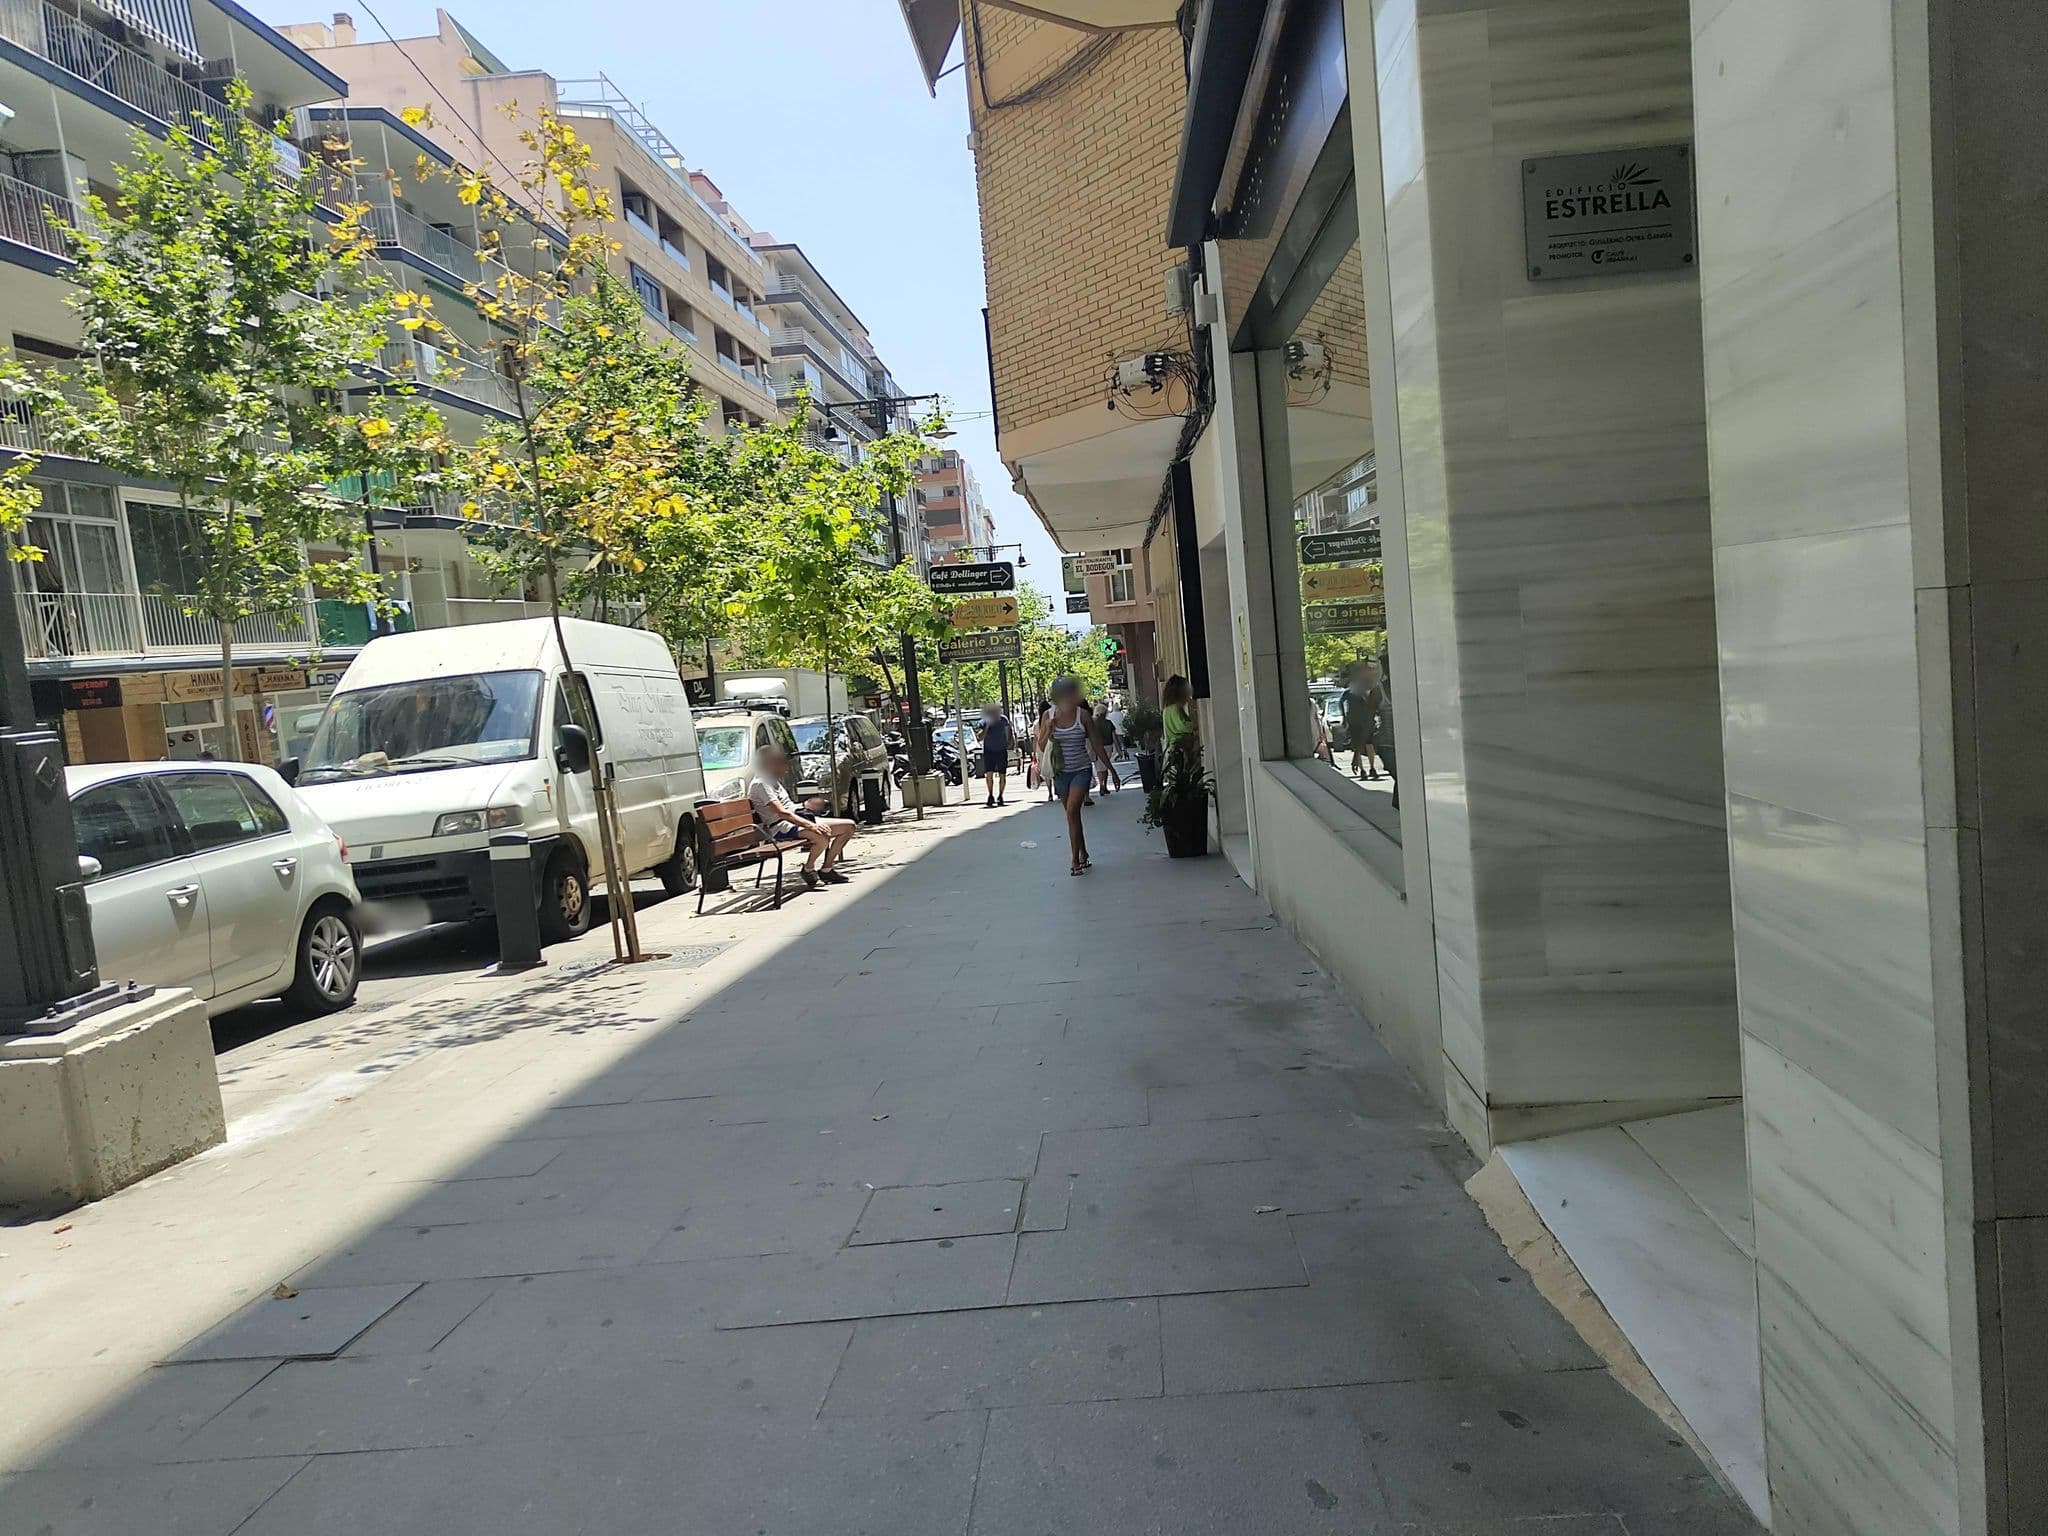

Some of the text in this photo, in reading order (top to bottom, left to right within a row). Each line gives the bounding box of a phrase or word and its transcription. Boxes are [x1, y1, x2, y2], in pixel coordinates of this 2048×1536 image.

[1545, 181, 1627, 198] EDIFICIO
[1545, 189, 1671, 219] ESTRELLA
[1075, 562, 1115, 573] EL BODEGON
[931, 569, 988, 581] Café Dollinger
[940, 637, 986, 650] Galerie
[190, 672, 222, 687] HAVANA
